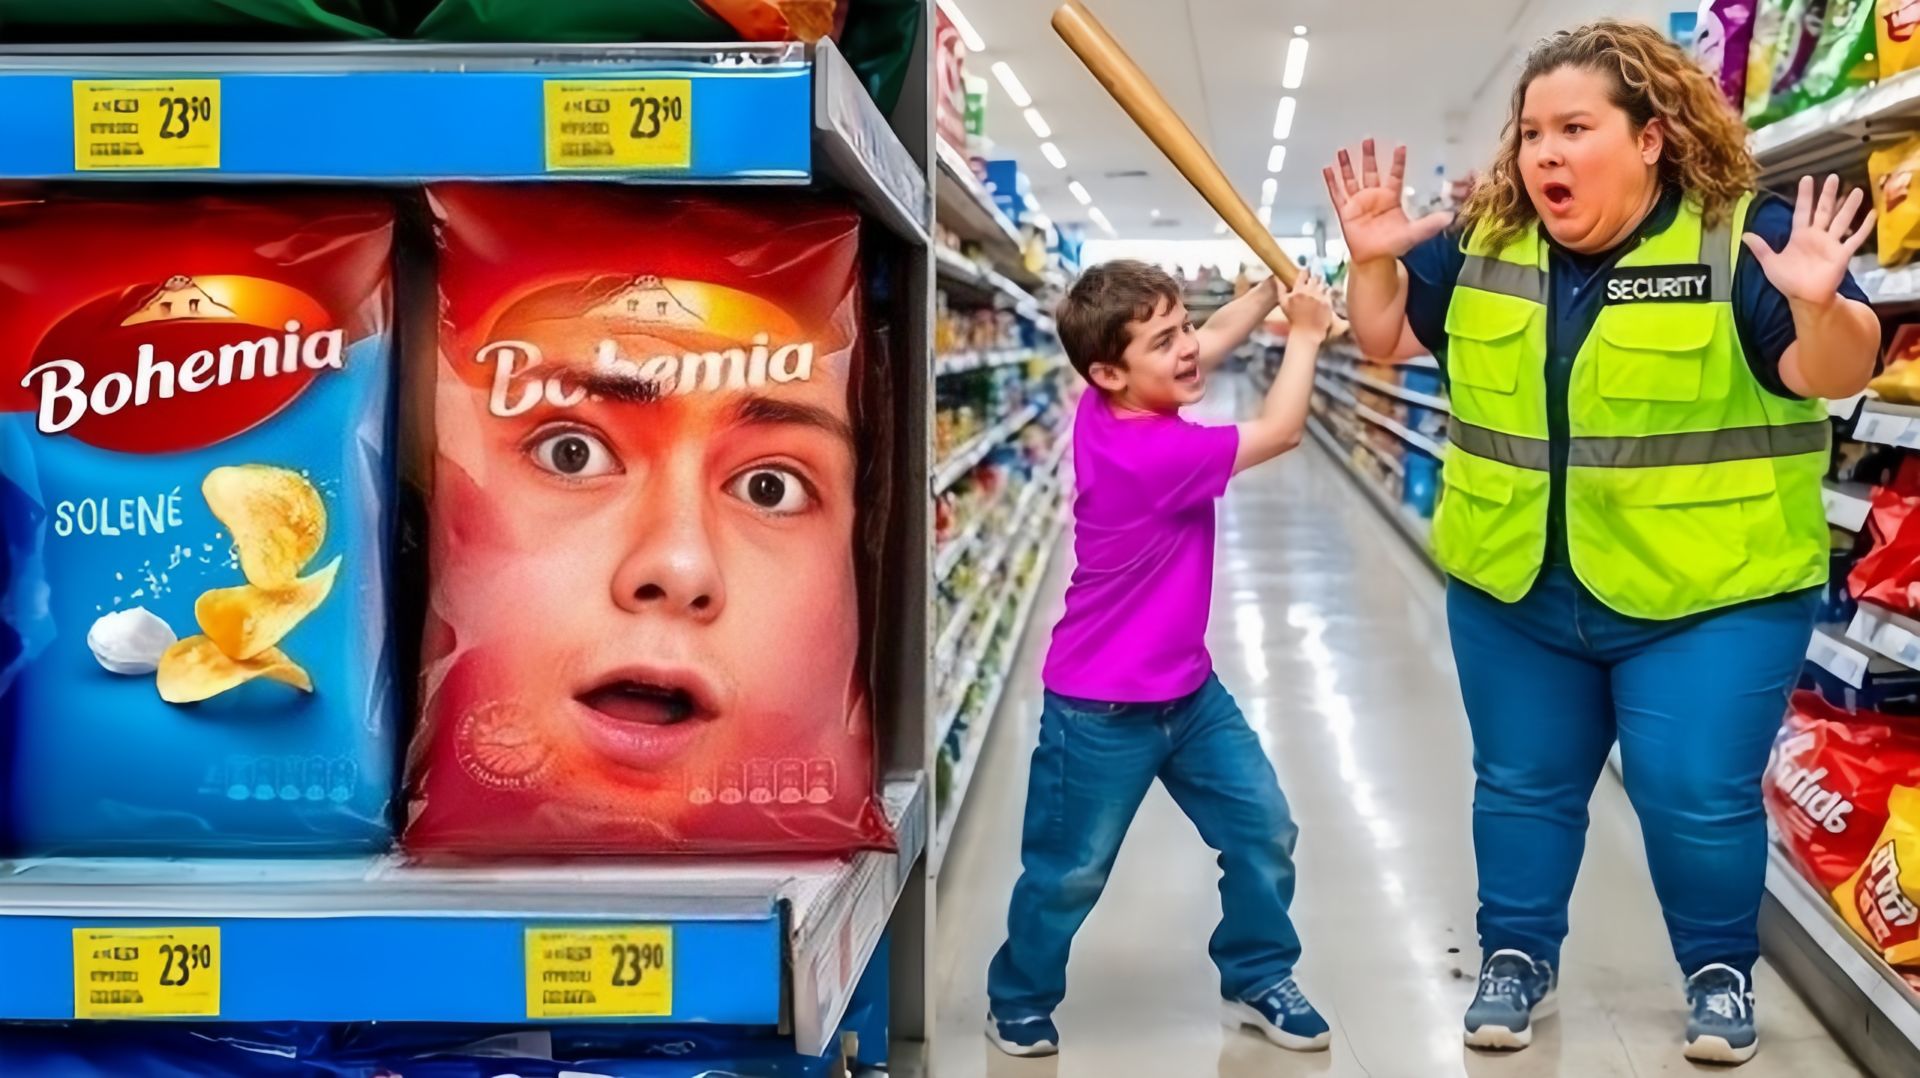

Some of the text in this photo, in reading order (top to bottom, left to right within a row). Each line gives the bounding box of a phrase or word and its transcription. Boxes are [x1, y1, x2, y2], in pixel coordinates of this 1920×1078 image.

[1607, 275, 1707, 300] SECURITY
[21, 320, 344, 433] Bohemia
[54, 486, 183, 536] SOLENÉ
